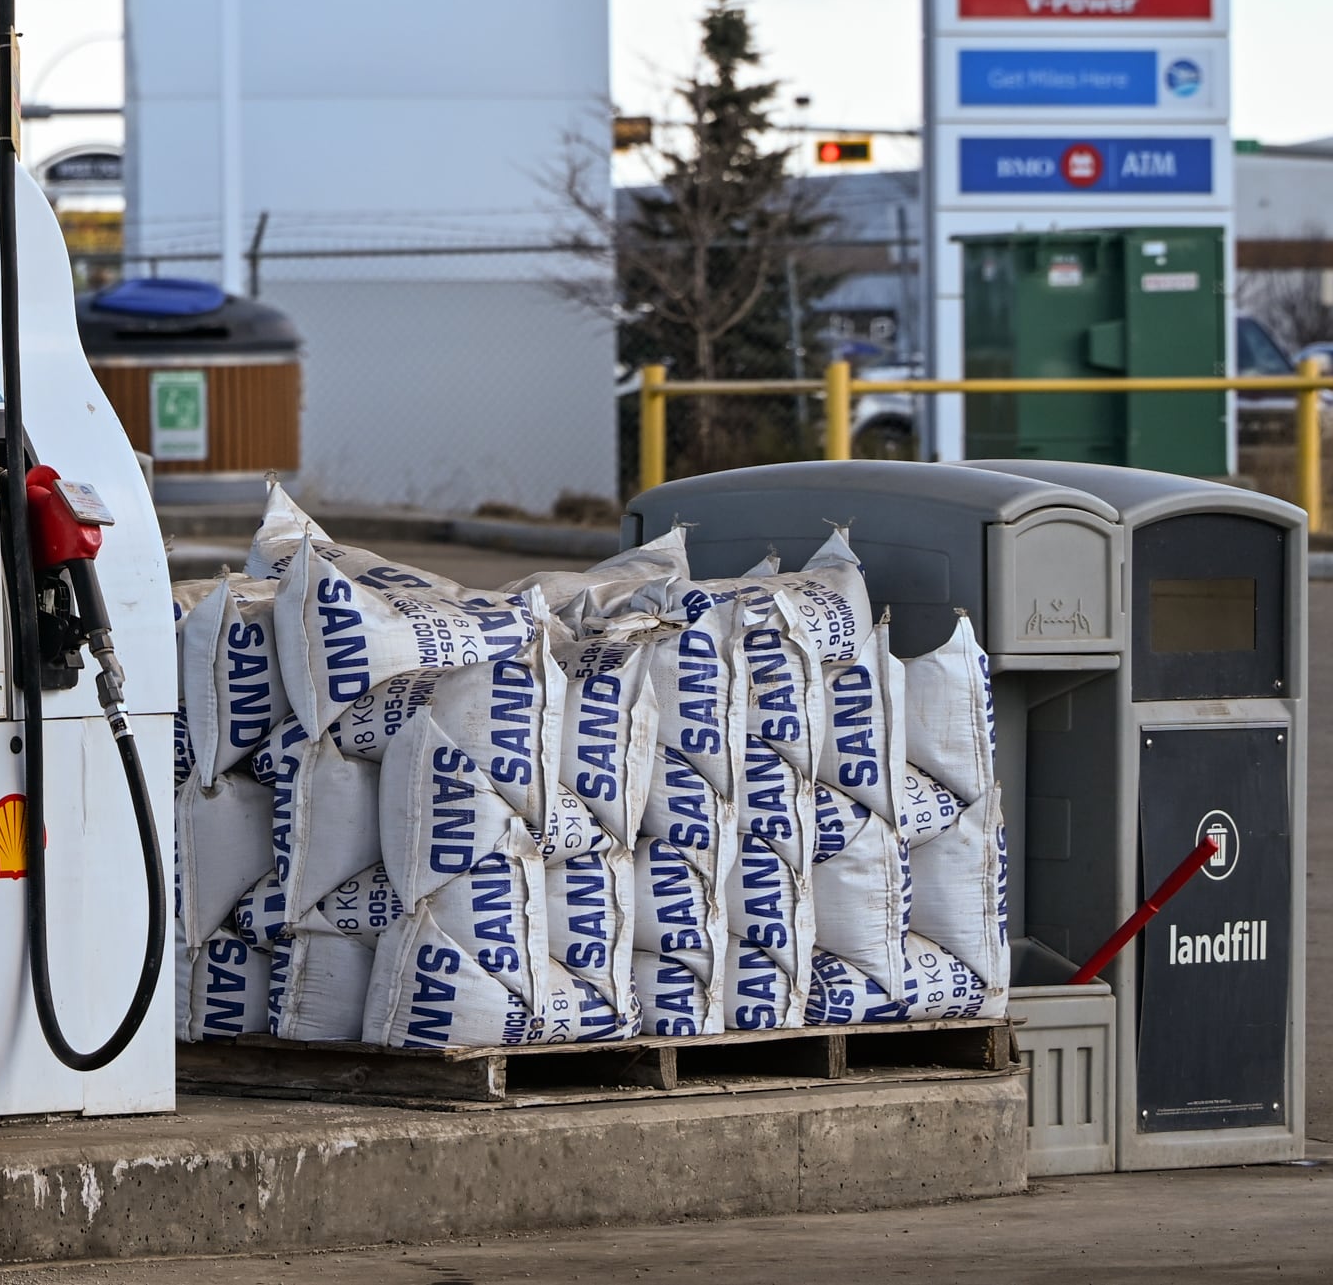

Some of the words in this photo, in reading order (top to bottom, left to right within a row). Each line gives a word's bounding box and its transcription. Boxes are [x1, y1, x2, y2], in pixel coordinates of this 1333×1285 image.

[227, 622, 271, 749] SAND
[317, 577, 371, 703] SAND
[460, 635, 479, 666] KG
[679, 630, 721, 755] SAND
[744, 628, 801, 742] SAND
[352, 695, 375, 725] KG
[354, 731, 377, 754] 18
[491, 660, 535, 786] SAND
[576, 674, 621, 801] SAND
[833, 664, 878, 788] SAND
[430, 746, 477, 874] SAND
[564, 816, 583, 849] KG
[665, 746, 711, 851] SAN
[745, 733, 793, 841] SAN
[905, 776, 928, 805] KG
[916, 811, 932, 835] 18
[336, 881, 359, 910] KG
[470, 851, 520, 973] SAND
[566, 850, 607, 969] SAND
[649, 838, 702, 953] SAND
[742, 833, 787, 949] SAND
[1169, 920, 1267, 965] landfill
[203, 939, 247, 1041] SAN
[403, 944, 461, 1049] SAN
[550, 988, 569, 1011] 18
[656, 955, 696, 1036] SAN
[736, 939, 777, 1030] SAN
[918, 952, 941, 984] KG
[925, 990, 944, 1013] 18
